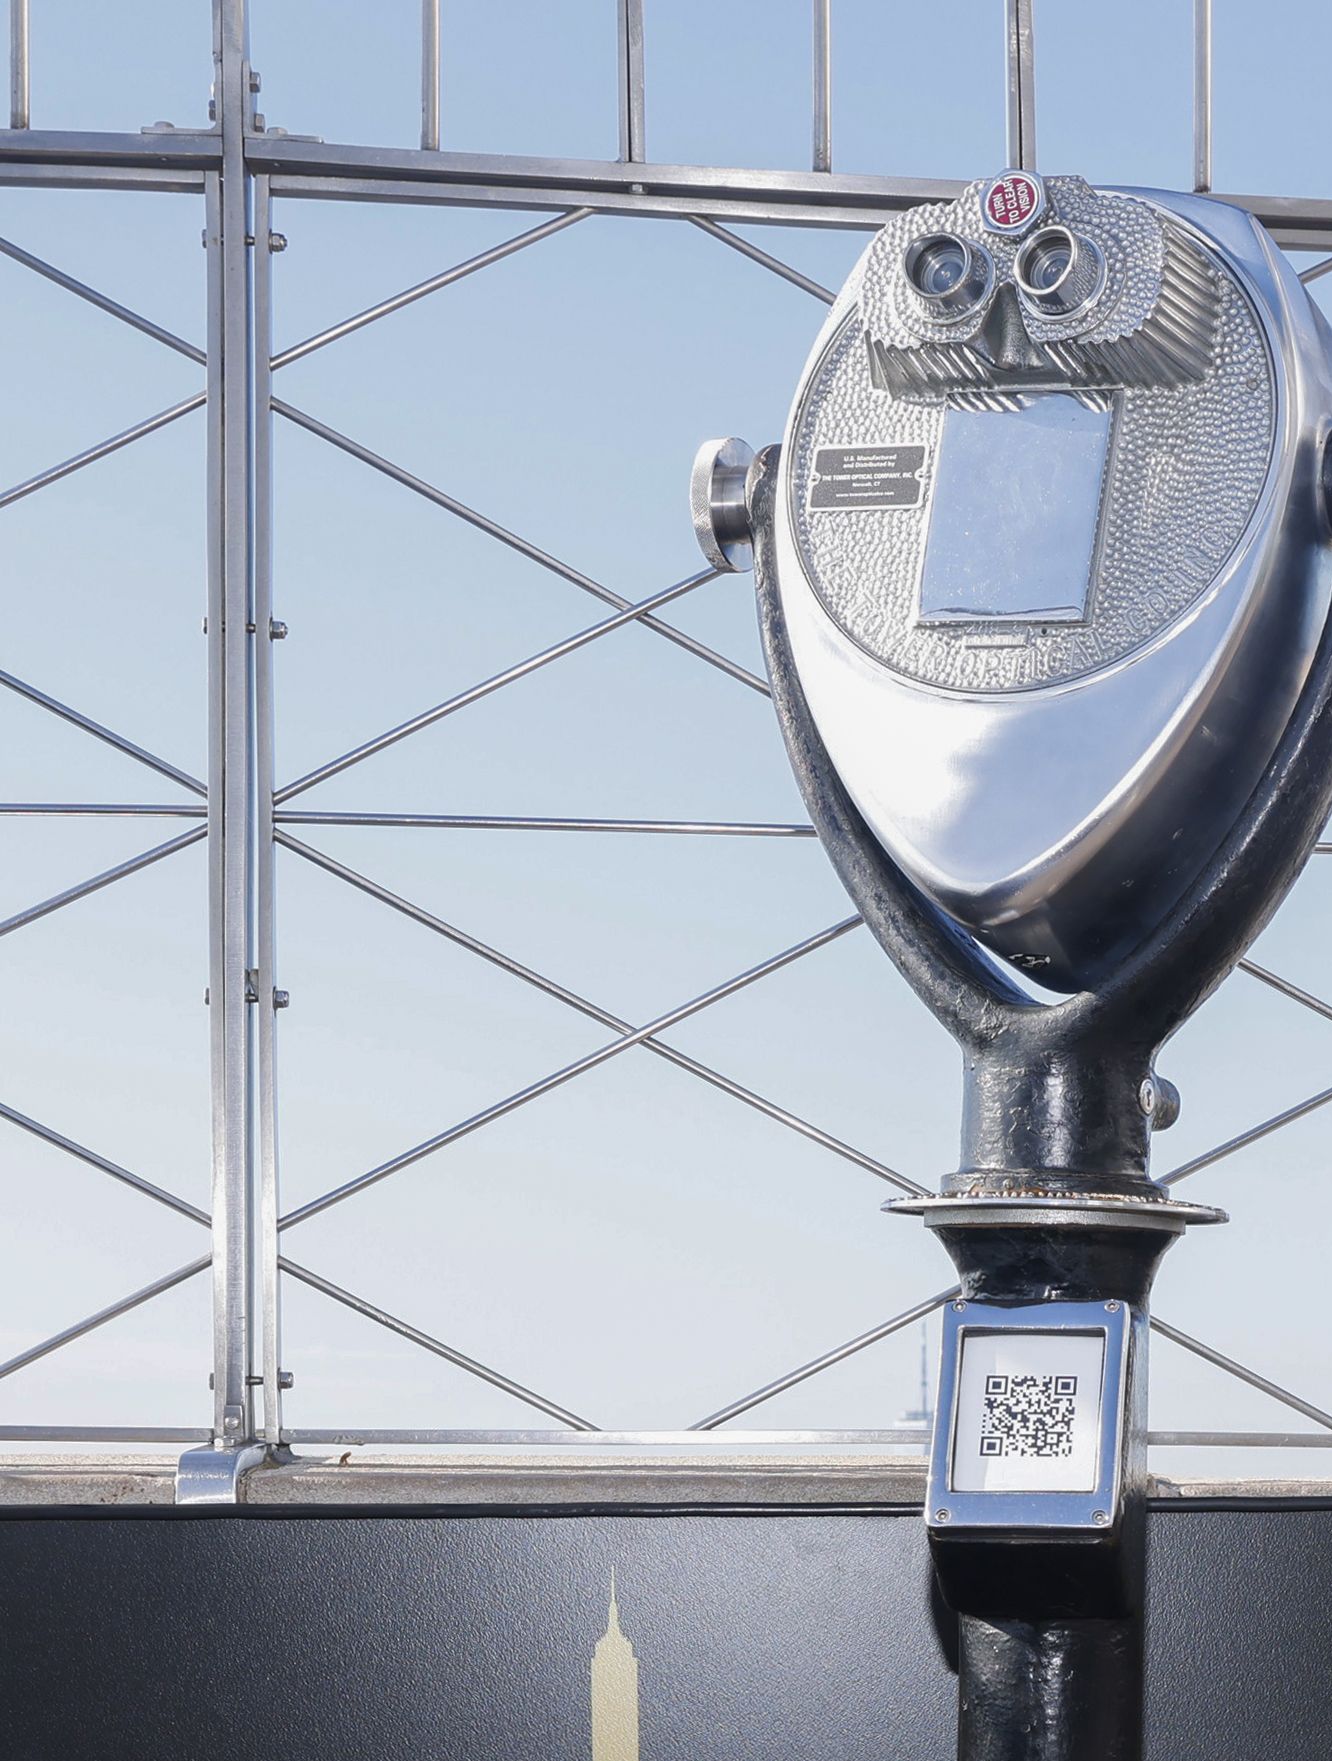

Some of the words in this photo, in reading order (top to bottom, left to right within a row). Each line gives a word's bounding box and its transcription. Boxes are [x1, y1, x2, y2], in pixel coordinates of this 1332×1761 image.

[992, 192, 1006, 219] TURN
[1002, 179, 1018, 210] CLEAR
[1016, 182, 1031, 213] VISION
[1008, 209, 1021, 224] TO
[855, 461, 887, 469] Distributed
[857, 454, 898, 462] Manufactured
[850, 590, 949, 673] TOWER
[954, 630, 1109, 682] OPTICAL
